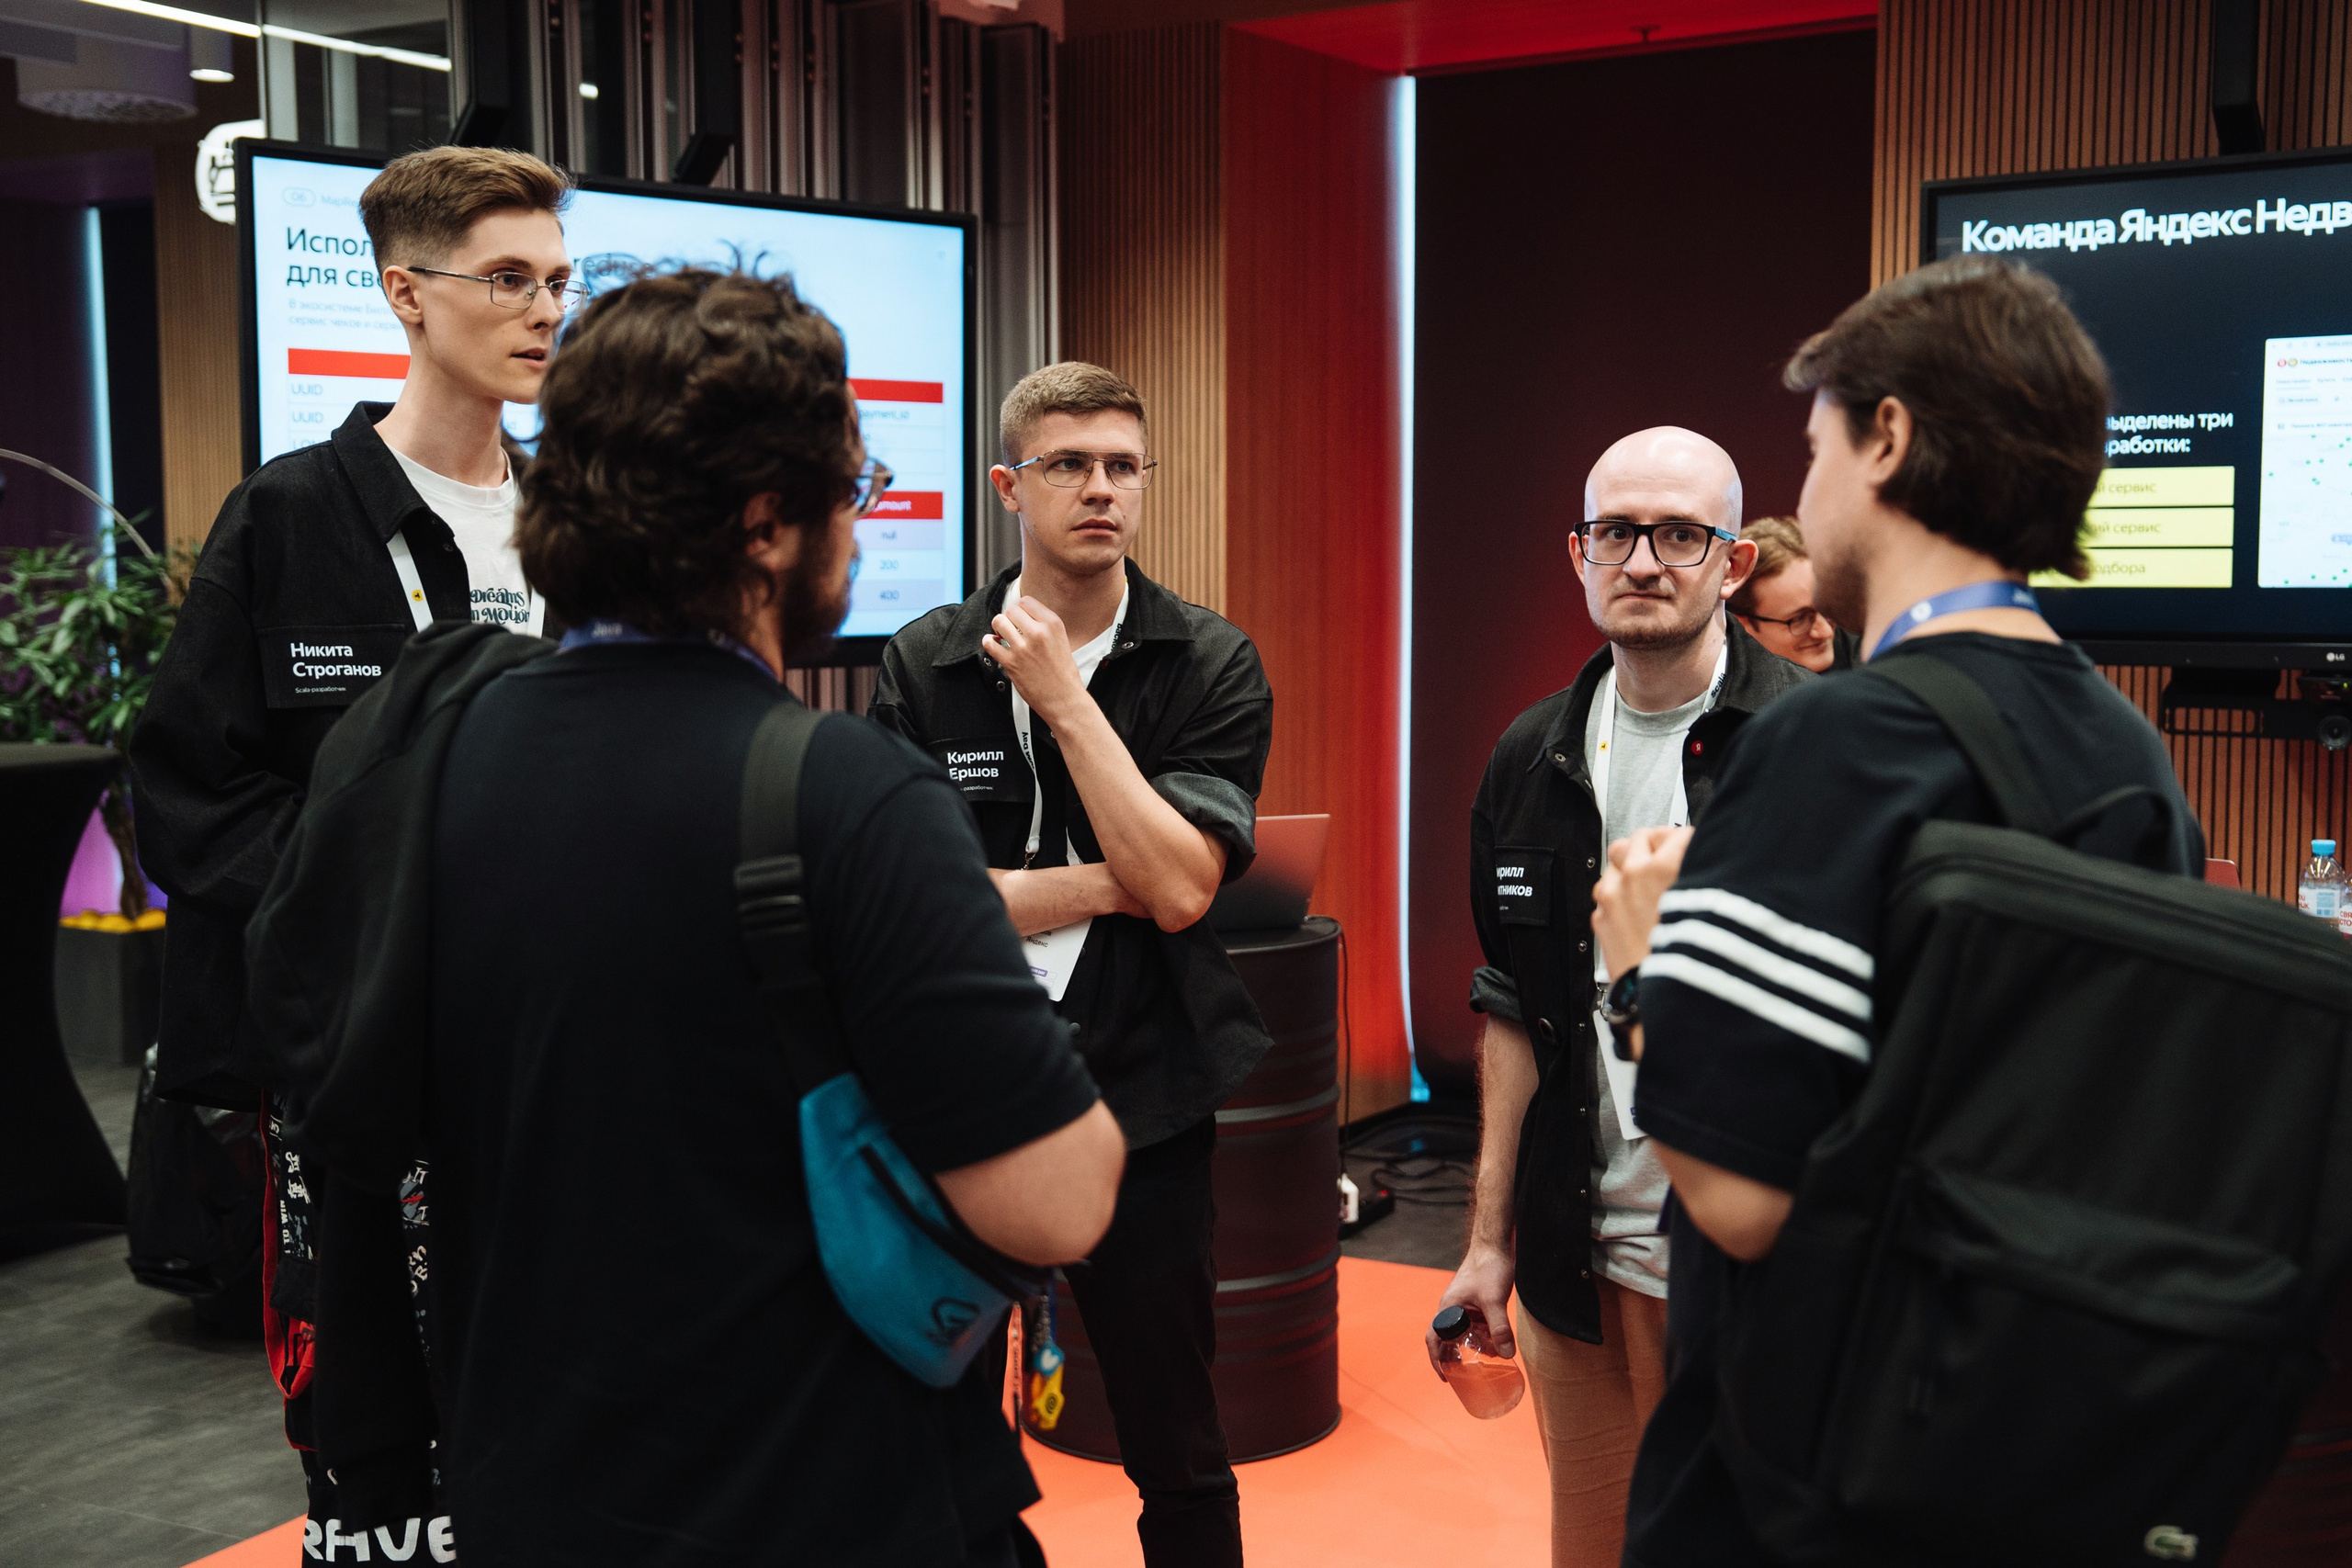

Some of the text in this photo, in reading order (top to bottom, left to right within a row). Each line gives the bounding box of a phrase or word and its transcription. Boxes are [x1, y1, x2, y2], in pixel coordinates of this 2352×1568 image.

[1962, 197, 2352, 253] Команда Яндекс Недв
[287, 265, 337, 288] для
[2198, 412, 2233, 431] три
[2105, 435, 2191, 458] работки:
[2109, 484, 2156, 494] сервис
[2113, 523, 2161, 535] сервис
[290, 643, 354, 658] Никита
[292, 661, 382, 680] Строганов
[947, 750, 1004, 764] Кирилл
[949, 767, 1000, 782] Ершов
[1025, 936, 1049, 948] Яндекс
